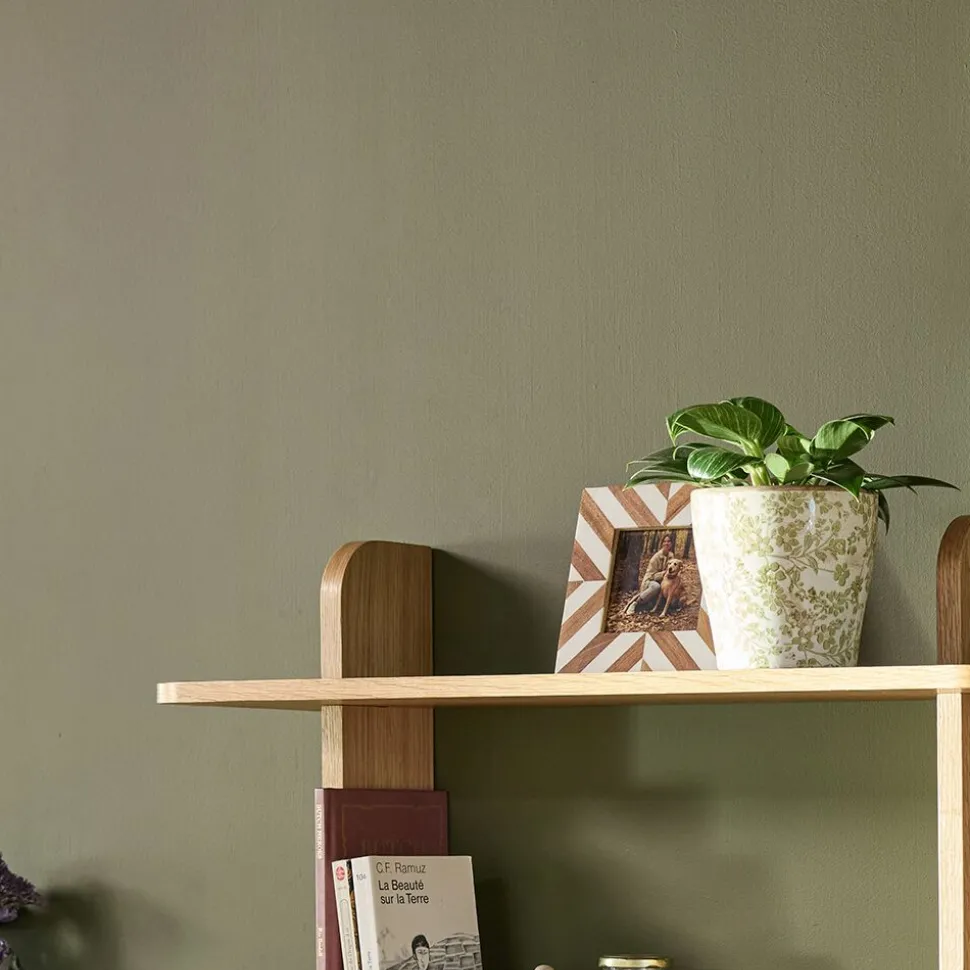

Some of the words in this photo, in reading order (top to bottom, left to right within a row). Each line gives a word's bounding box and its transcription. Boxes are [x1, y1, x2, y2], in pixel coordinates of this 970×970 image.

[395, 861, 426, 874] Ramuz
[378, 880, 389, 891] La
[391, 879, 424, 891] Beauté
[380, 895, 394, 905] sur
[396, 893, 405, 904] la
[405, 893, 430, 904] Terre
